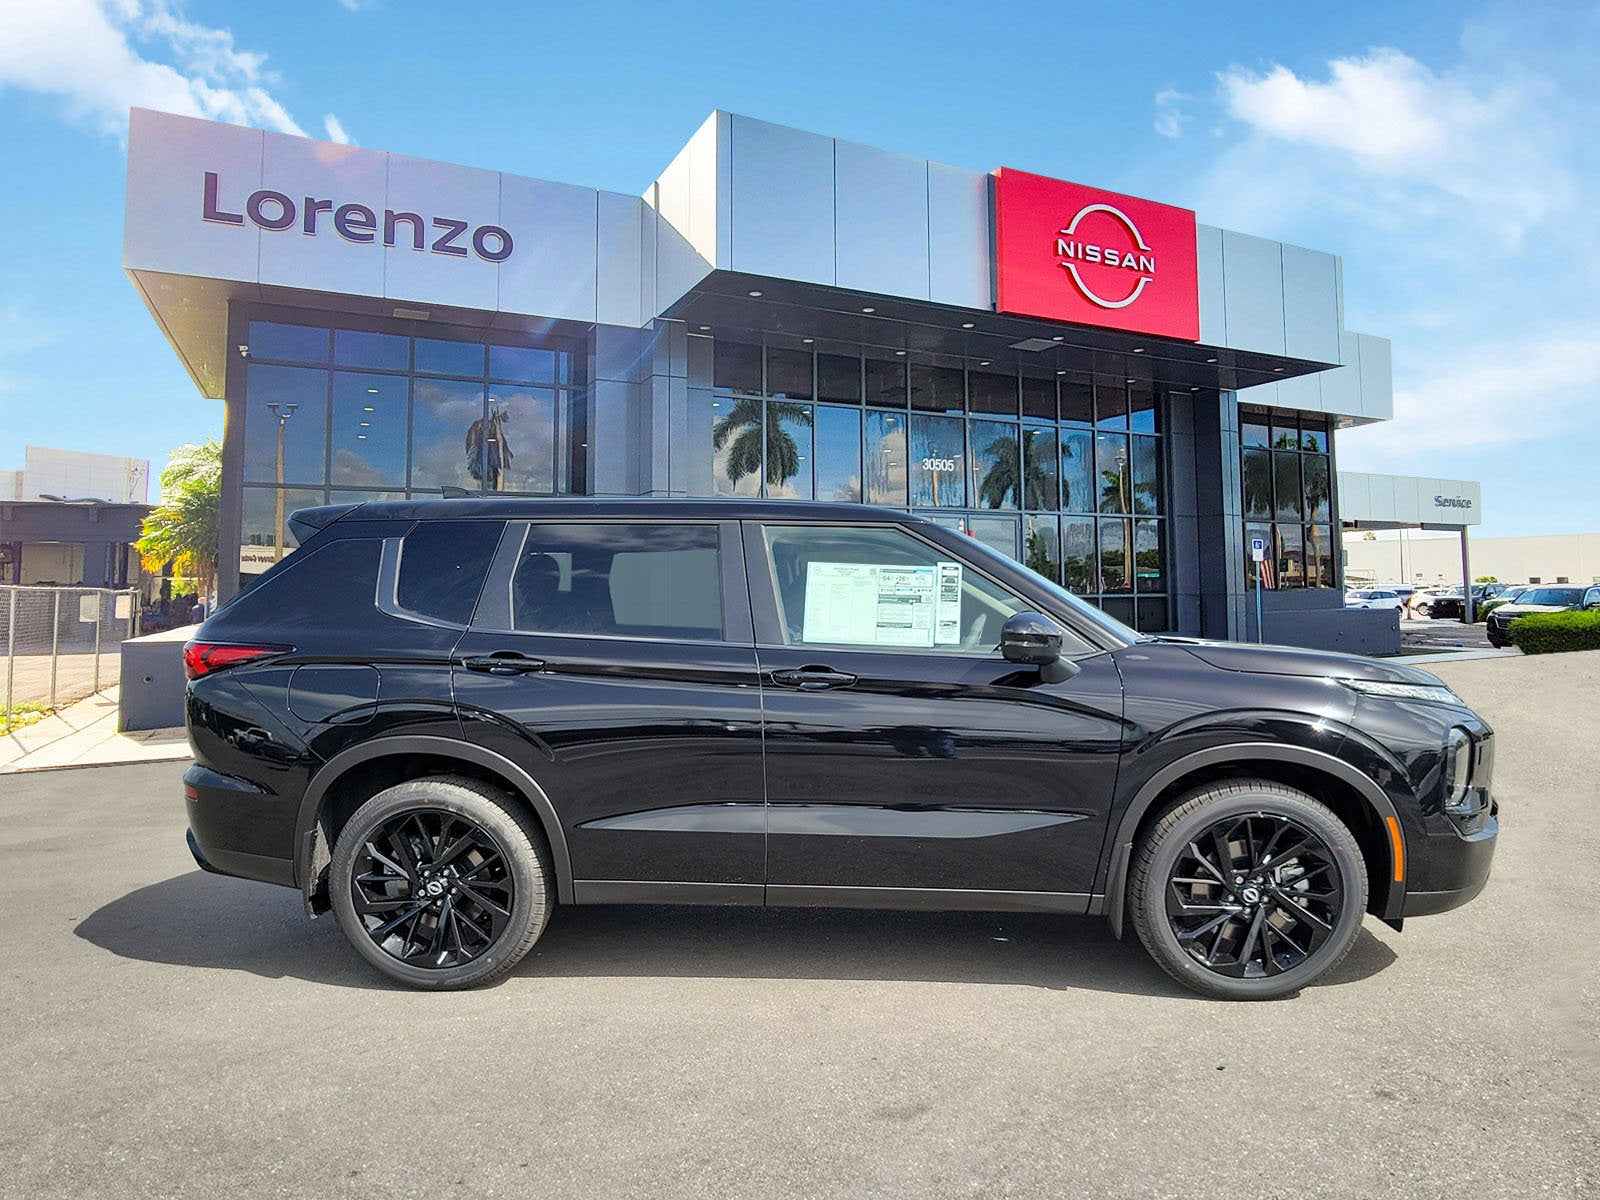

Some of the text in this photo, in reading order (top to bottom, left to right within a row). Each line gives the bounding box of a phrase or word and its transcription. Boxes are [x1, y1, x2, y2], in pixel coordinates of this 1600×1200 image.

[202, 171, 514, 262] Lorenzo
[1057, 238, 1155, 273] NISSAN
[922, 457, 955, 472] 30505
[1434, 495, 1472, 509] Service
